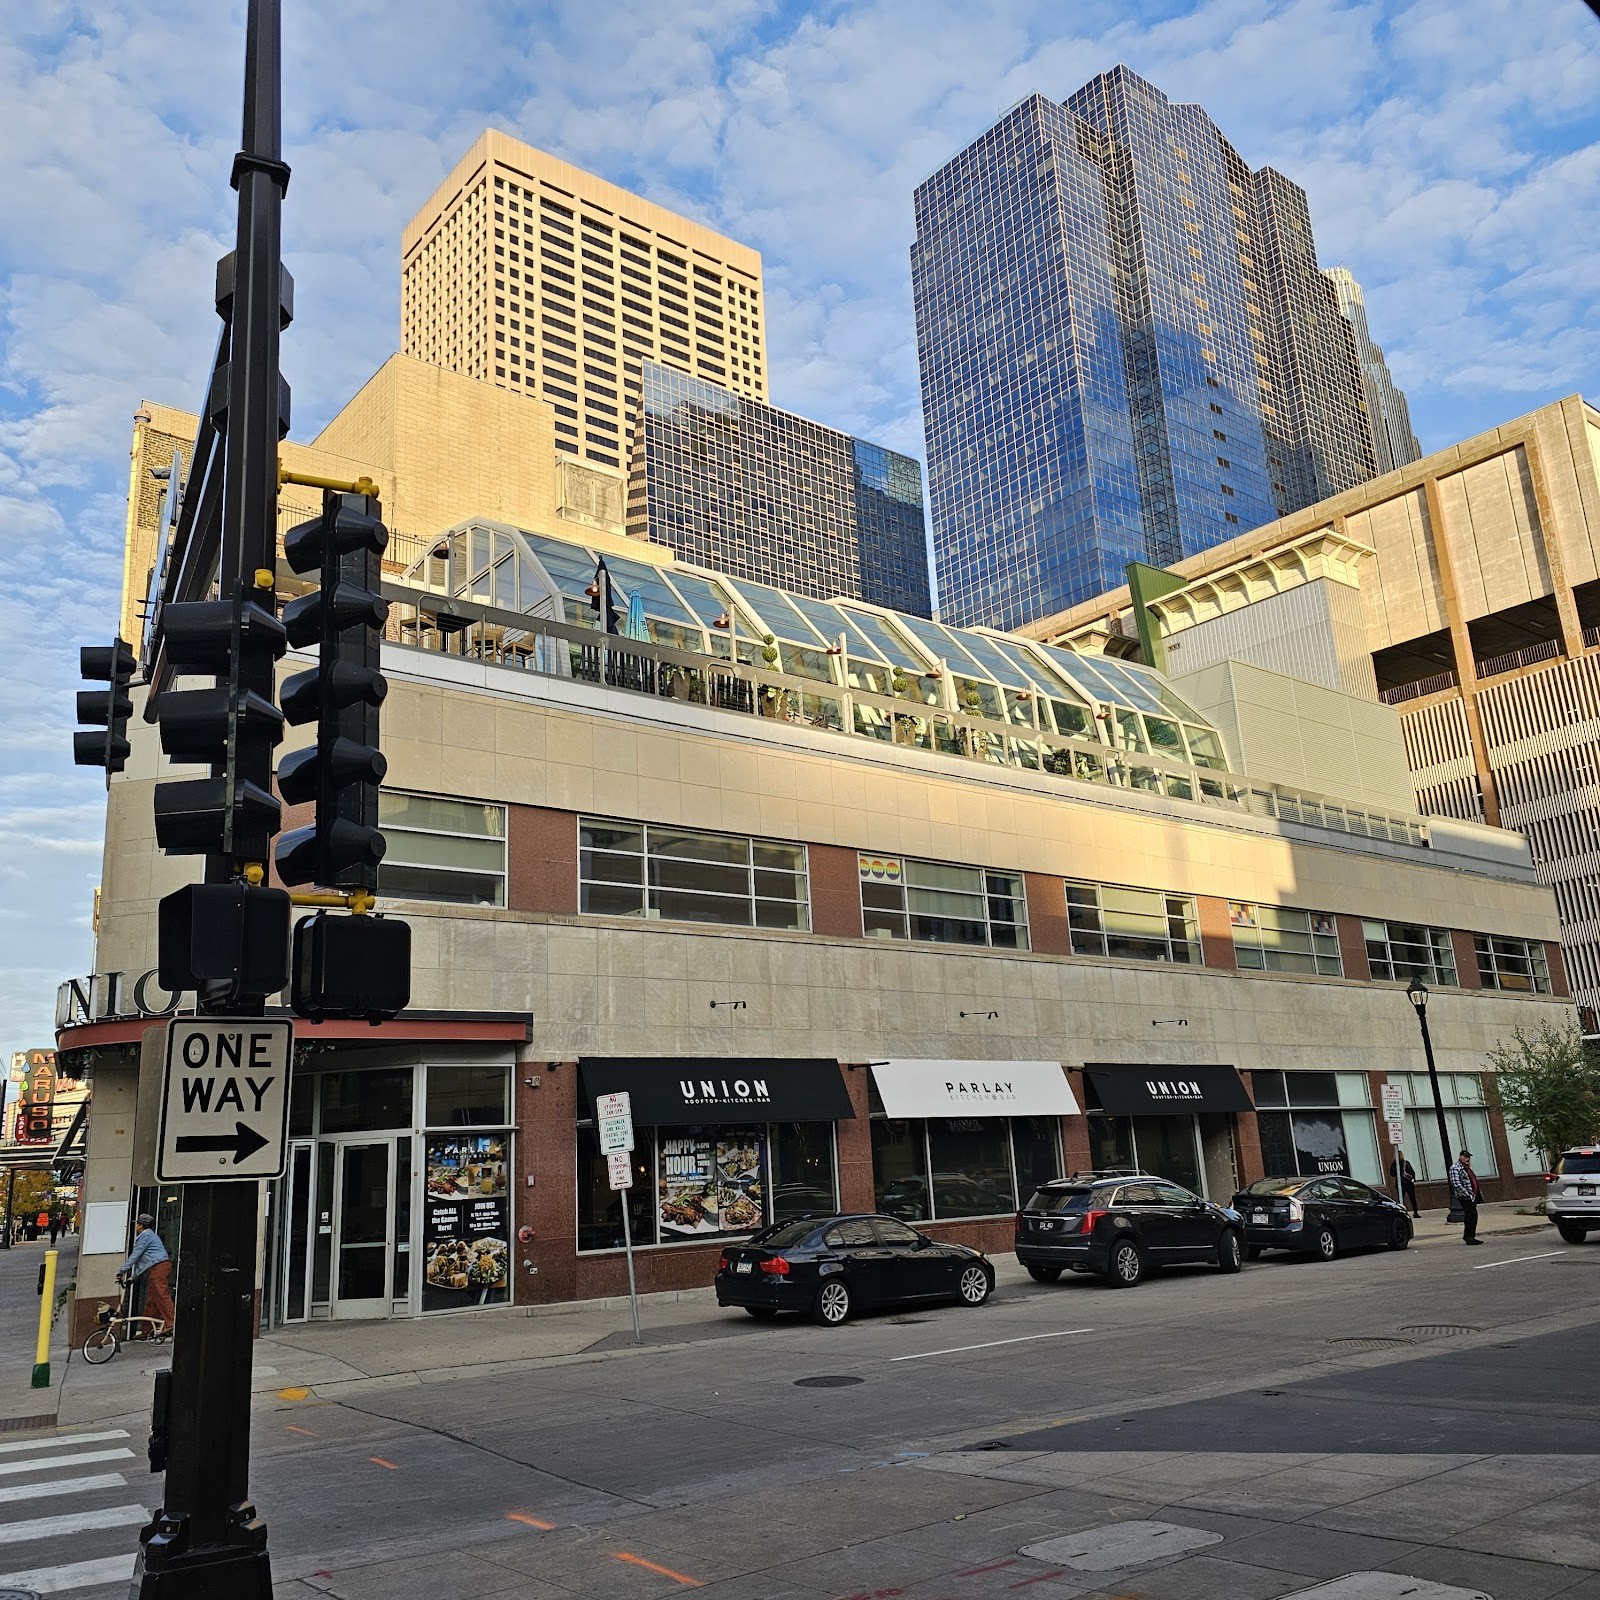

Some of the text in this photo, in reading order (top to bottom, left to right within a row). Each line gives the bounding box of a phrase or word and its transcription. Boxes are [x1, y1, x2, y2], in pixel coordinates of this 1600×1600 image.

[183, 1033, 273, 1068] ONE
[30, 1052, 56, 1130] MARUSO
[680, 1080, 769, 1098] UNION
[945, 1082, 1012, 1093] PARLAY
[1146, 1081, 1201, 1095] UNION
[183, 1077, 275, 1113] WAY
[604, 1102, 624, 1110] STOPPING
[445, 1146, 491, 1154] PARLAY
[665, 1139, 695, 1154] HAPPY
[666, 1155, 696, 1175] HOUR
[1318, 1161, 1343, 1171] UNION
[433, 1208, 448, 1216] Catch
